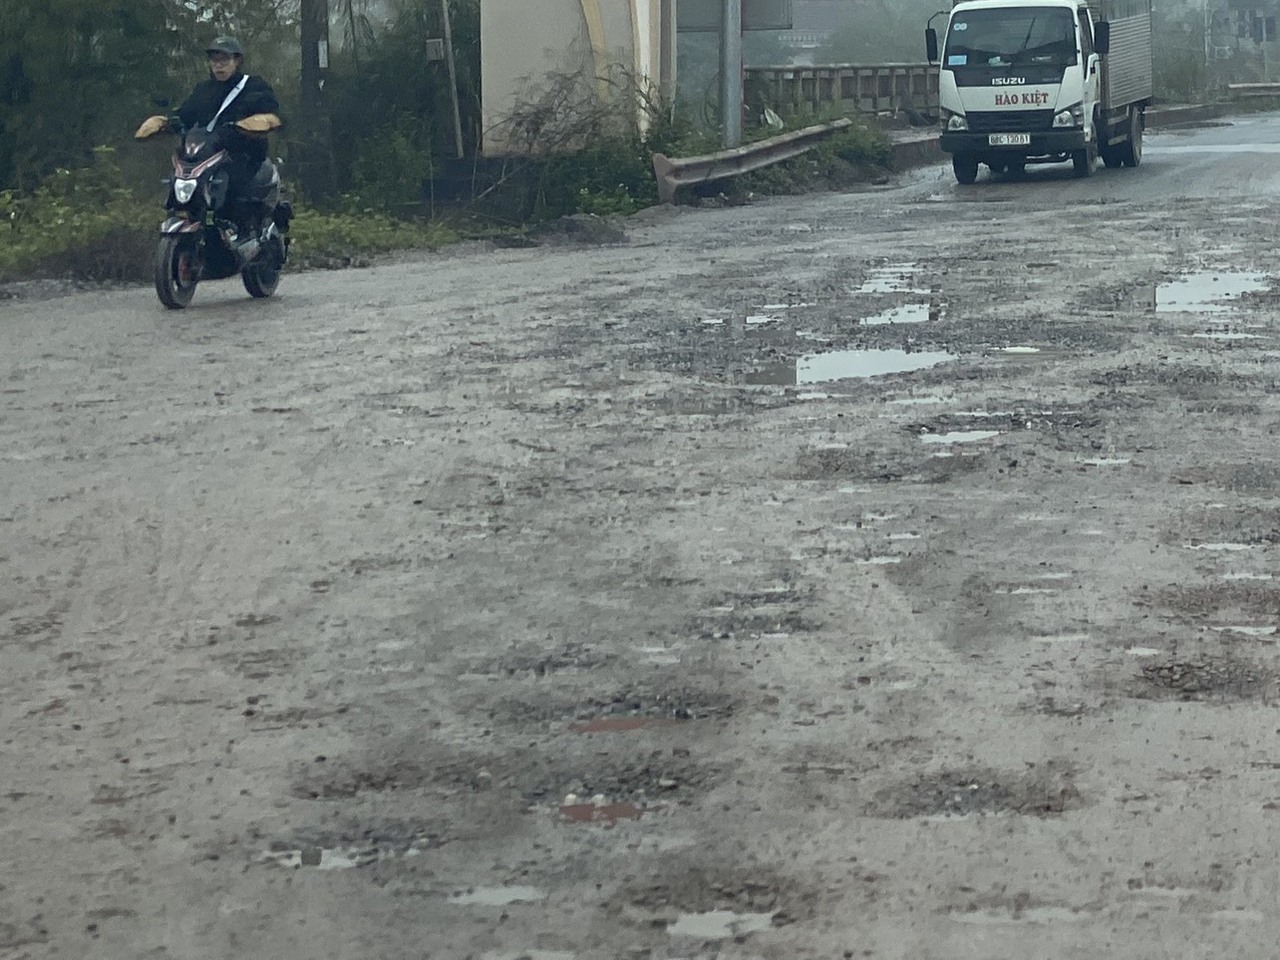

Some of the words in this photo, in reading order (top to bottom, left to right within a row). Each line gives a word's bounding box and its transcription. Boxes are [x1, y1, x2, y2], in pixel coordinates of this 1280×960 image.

[991, 77, 1026, 86] ISUZU
[994, 91, 1019, 106] HÀO
[1022, 89, 1049, 107] KIỆT
